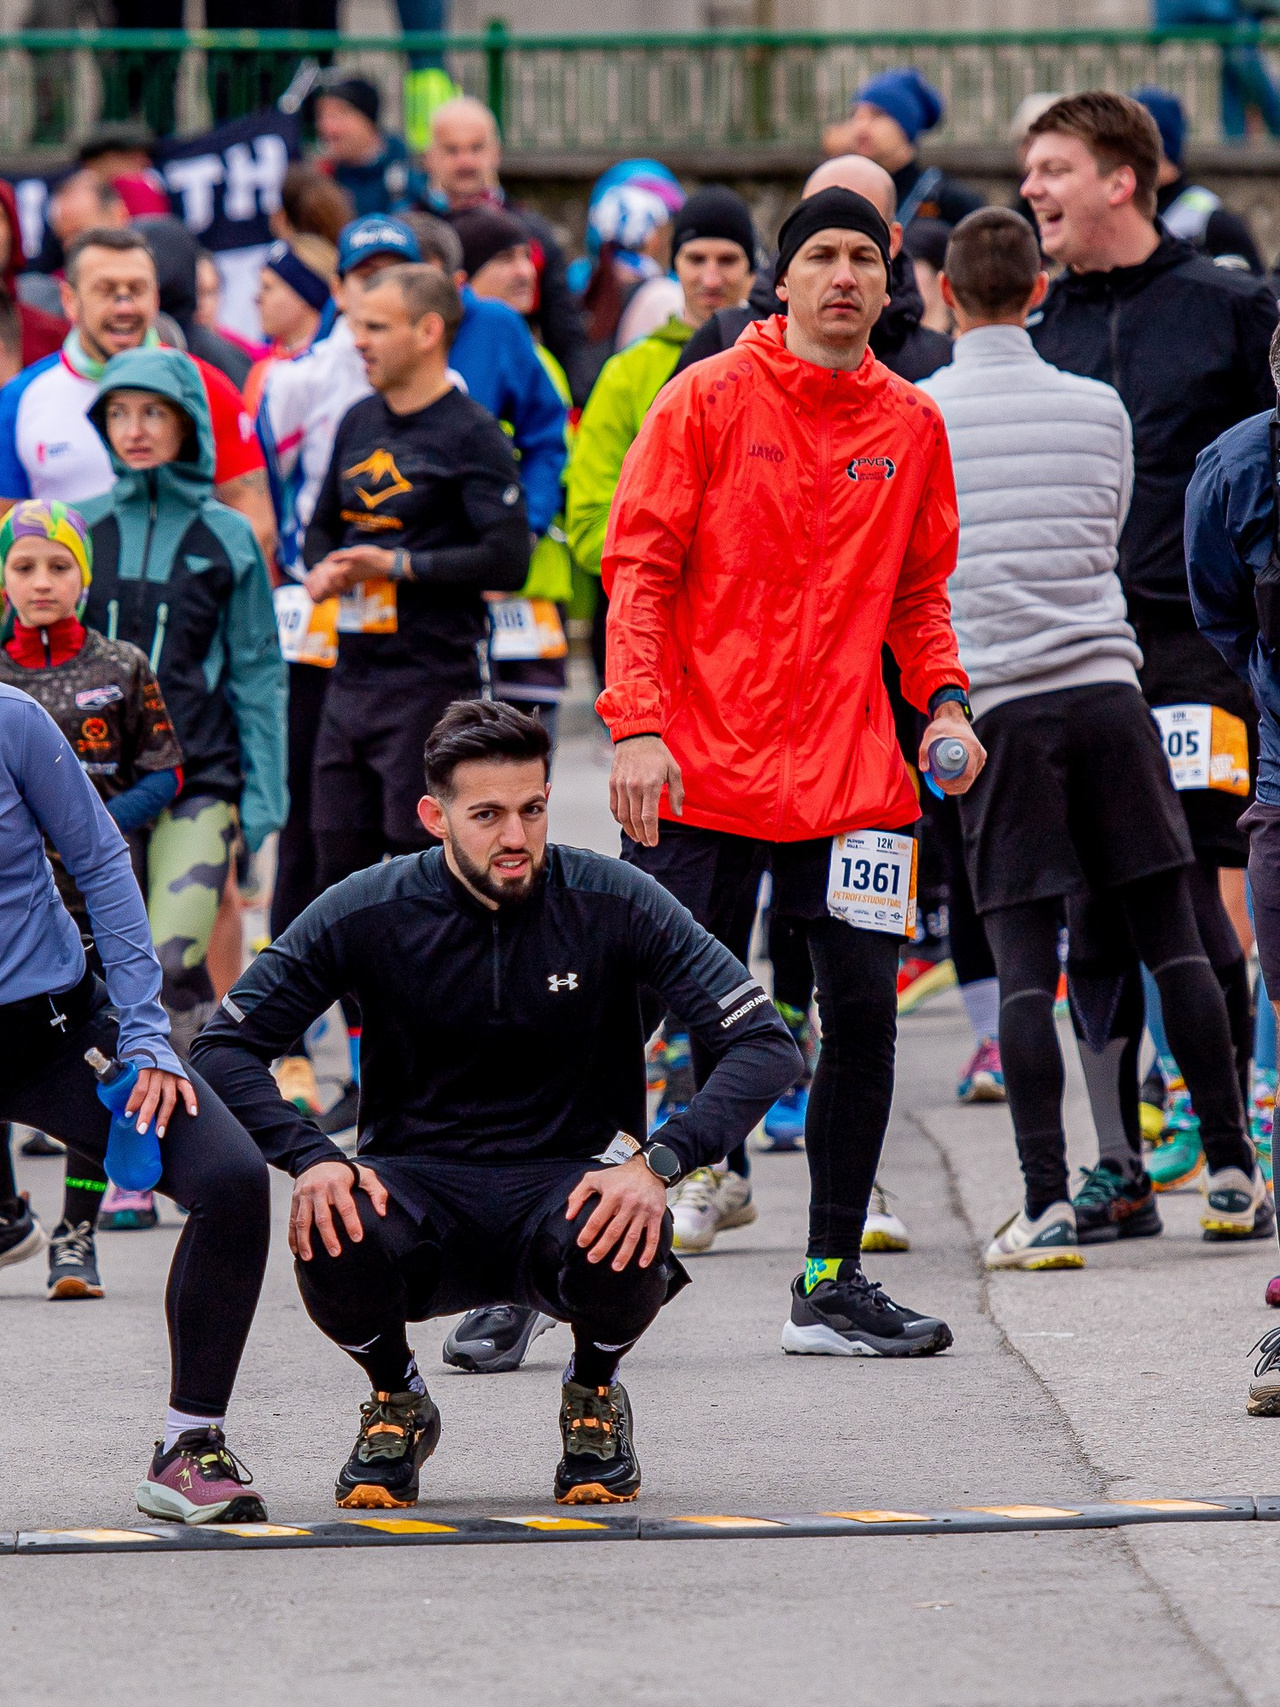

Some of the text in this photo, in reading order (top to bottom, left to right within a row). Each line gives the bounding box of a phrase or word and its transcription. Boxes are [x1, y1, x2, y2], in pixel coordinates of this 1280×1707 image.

[748, 444, 785, 463] JAKO
[857, 457, 885, 467] PVG
[877, 836, 893, 850] 12K
[841, 857, 900, 895] 1361
